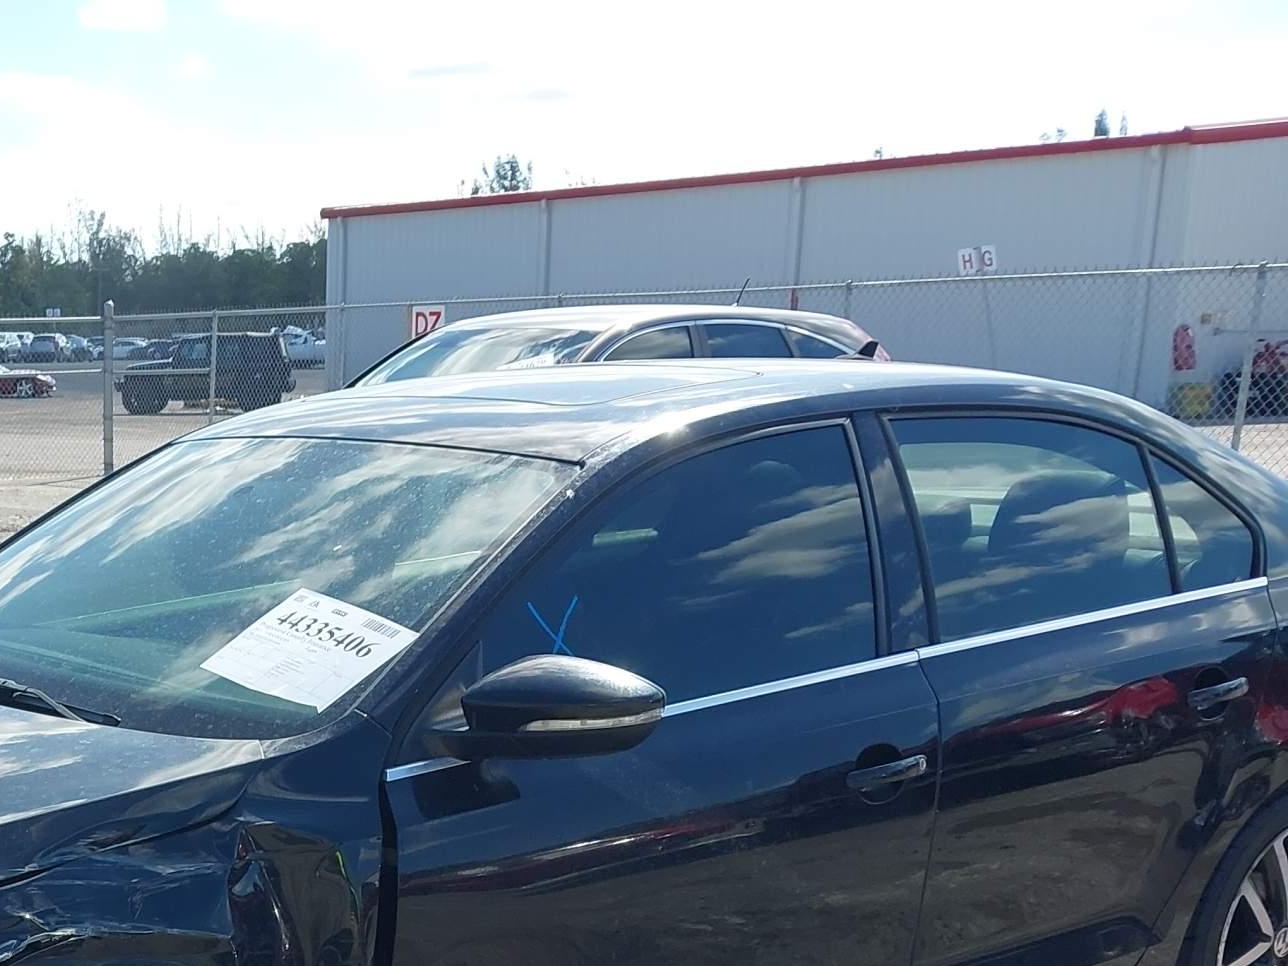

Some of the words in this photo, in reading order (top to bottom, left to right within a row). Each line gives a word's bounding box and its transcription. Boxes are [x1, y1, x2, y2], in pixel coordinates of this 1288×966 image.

[961, 253, 974, 270] H
[982, 250, 993, 267] G
[277, 611, 380, 658] 44335406
